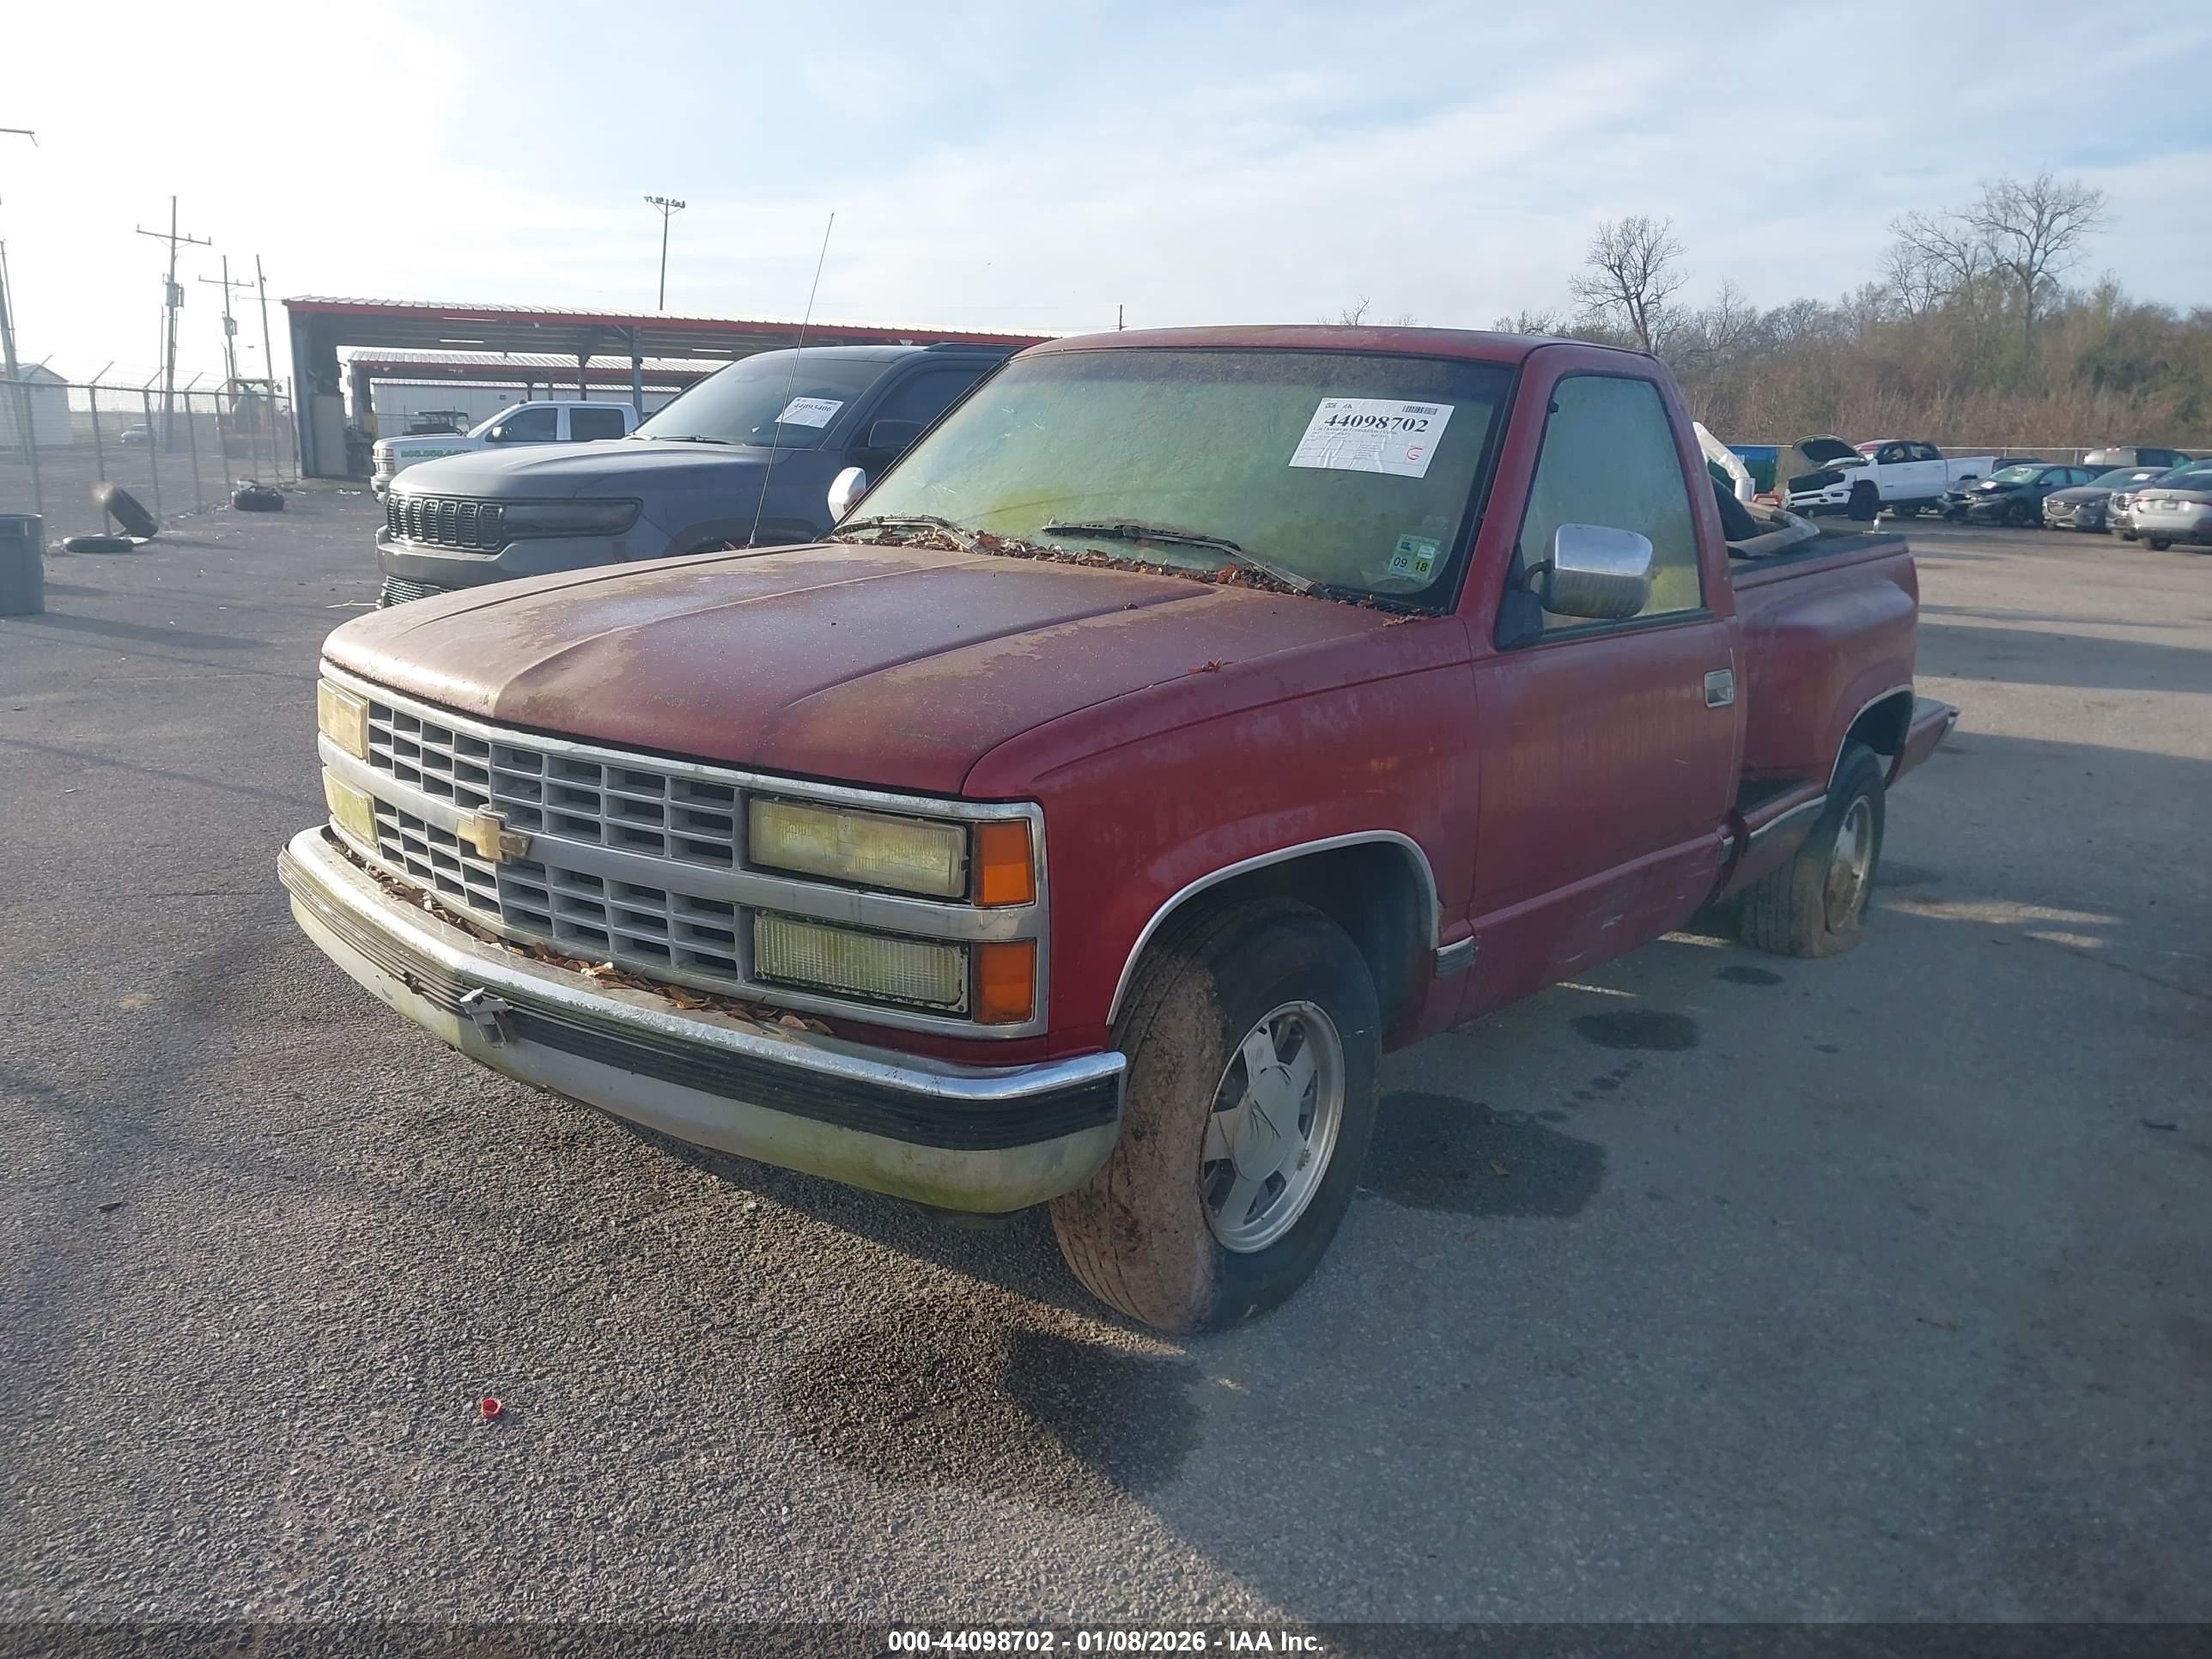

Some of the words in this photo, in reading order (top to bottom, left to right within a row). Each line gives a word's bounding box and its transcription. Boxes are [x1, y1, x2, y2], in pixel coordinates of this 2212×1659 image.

[1324, 414, 1429, 433] 44098702
[1394, 556, 1407, 568] 09
[1415, 561, 1428, 572] 18
